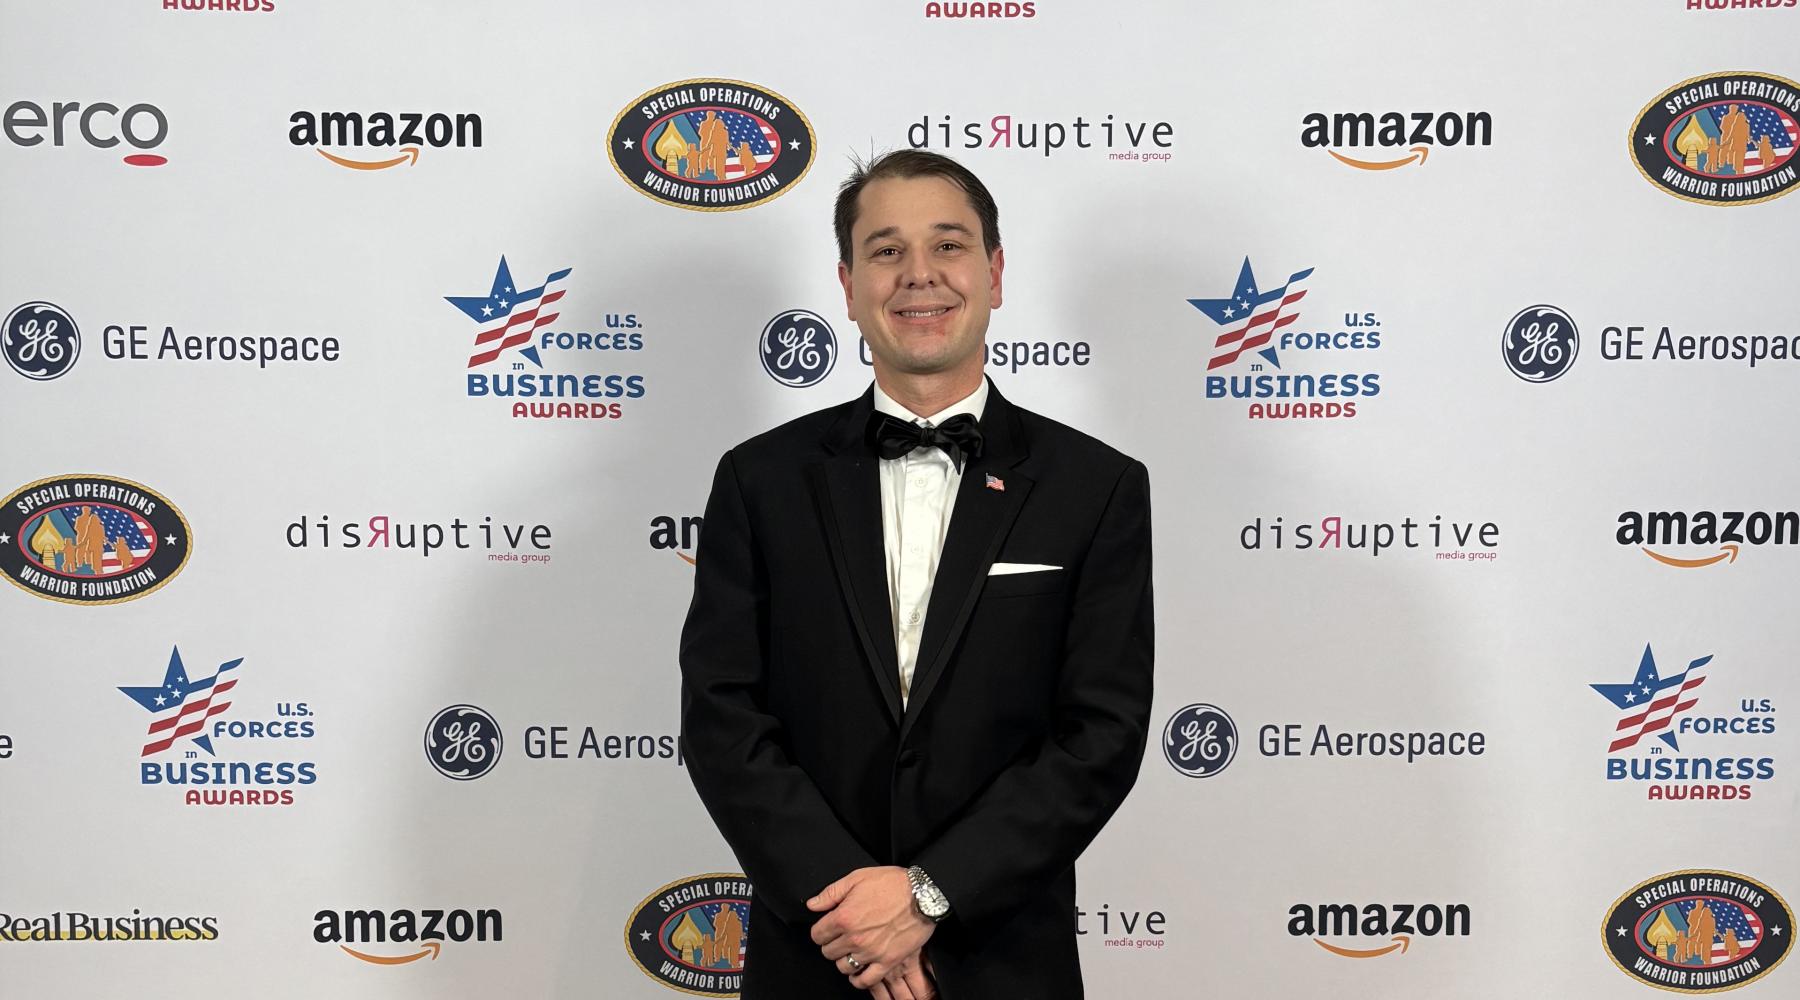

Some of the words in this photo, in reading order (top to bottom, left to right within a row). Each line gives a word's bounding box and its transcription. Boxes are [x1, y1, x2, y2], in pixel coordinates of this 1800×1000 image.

[926, 2, 1035, 18] AWARDS
[642, 89, 695, 119] SPECIAL
[700, 87, 780, 120] OPERATIONS
[1665, 83, 1719, 114] SPECIAL
[1724, 81, 1800, 112] OPERATIONS
[289, 111, 481, 147] amazon
[1301, 112, 1491, 146] amazon
[1109, 151, 1139, 160] media
[1142, 153, 1171, 162] group
[643, 171, 699, 201] WARRIOR
[704, 173, 779, 202] FOUNDATION
[1662, 166, 1717, 196] WARRIOR
[1721, 166, 1796, 197] FOUNDATION
[606, 314, 642, 328] U.S.
[1345, 313, 1380, 327] U.S.
[103, 325, 148, 359] GE
[158, 327, 339, 368] Aerospace
[542, 333, 643, 350] FORCES
[1280, 332, 1380, 350] FORCES
[1601, 327, 1644, 360] GE
[468, 374, 645, 398] BUSINESS
[1206, 374, 1380, 398] BUSINESS
[513, 402, 622, 419] AWARDS
[1249, 402, 1356, 419] AWARDS
[17, 485, 70, 514] SPECIAL
[75, 483, 156, 515] OPERATIONS
[1616, 511, 1800, 545] amazon
[488, 552, 518, 561] media
[521, 555, 550, 564] group
[1436, 551, 1465, 559] media
[1468, 553, 1496, 562] group
[20, 565, 77, 596] WARRIOR
[82, 567, 156, 596] FOUNDATION
[278, 703, 313, 716] U.S.
[1742, 699, 1775, 712] U.S.
[214, 721, 314, 738] FORCES
[1680, 717, 1775, 734] FORCES
[525, 726, 568, 759] GE
[1259, 725, 1301, 756] GE
[1310, 725, 1485, 763] Aerospace
[141, 762, 316, 784] BUSINESS
[1607, 758, 1774, 780] BUSINESS
[186, 790, 293, 805] AWARDS
[1648, 785, 1751, 800] AWARDS
[659, 884, 710, 912] SPECIAL
[1635, 880, 1686, 909] SPECIAL
[1690, 878, 1764, 908] OPERATIONS
[314, 909, 502, 944] amazon
[1288, 904, 1470, 937] amazon
[1105, 937, 1133, 946] media
[1136, 940, 1164, 949] group
[660, 961, 714, 988] WARRIOR
[1634, 957, 1686, 985] WARRIOR
[1690, 957, 1761, 985] FOUNDATION
